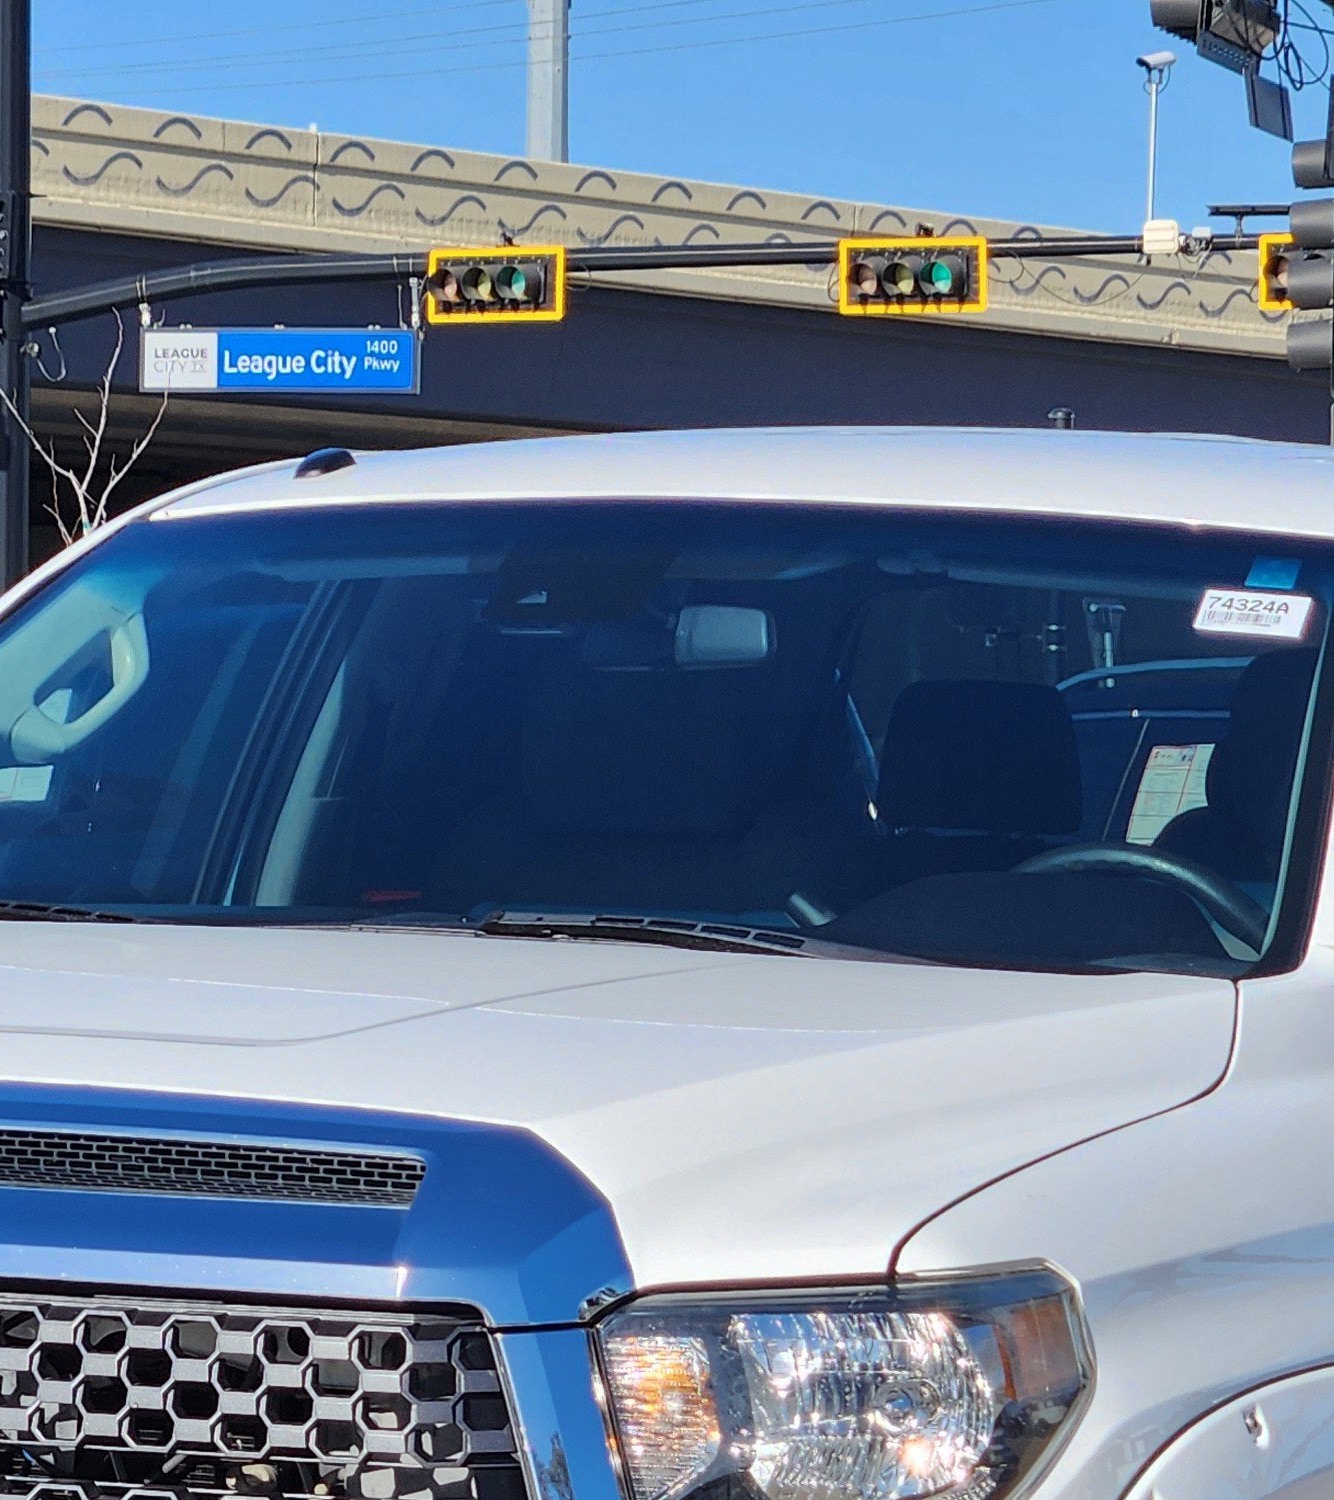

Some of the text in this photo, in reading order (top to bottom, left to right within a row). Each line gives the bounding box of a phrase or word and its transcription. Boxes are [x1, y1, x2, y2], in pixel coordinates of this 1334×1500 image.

[154, 348, 208, 358] LEAGUE
[366, 340, 398, 354] 1400
[154, 361, 185, 373] CITY
[223, 349, 357, 380] League City
[364, 356, 400, 372] Pkwy
[1208, 596, 1289, 615] 74324A
